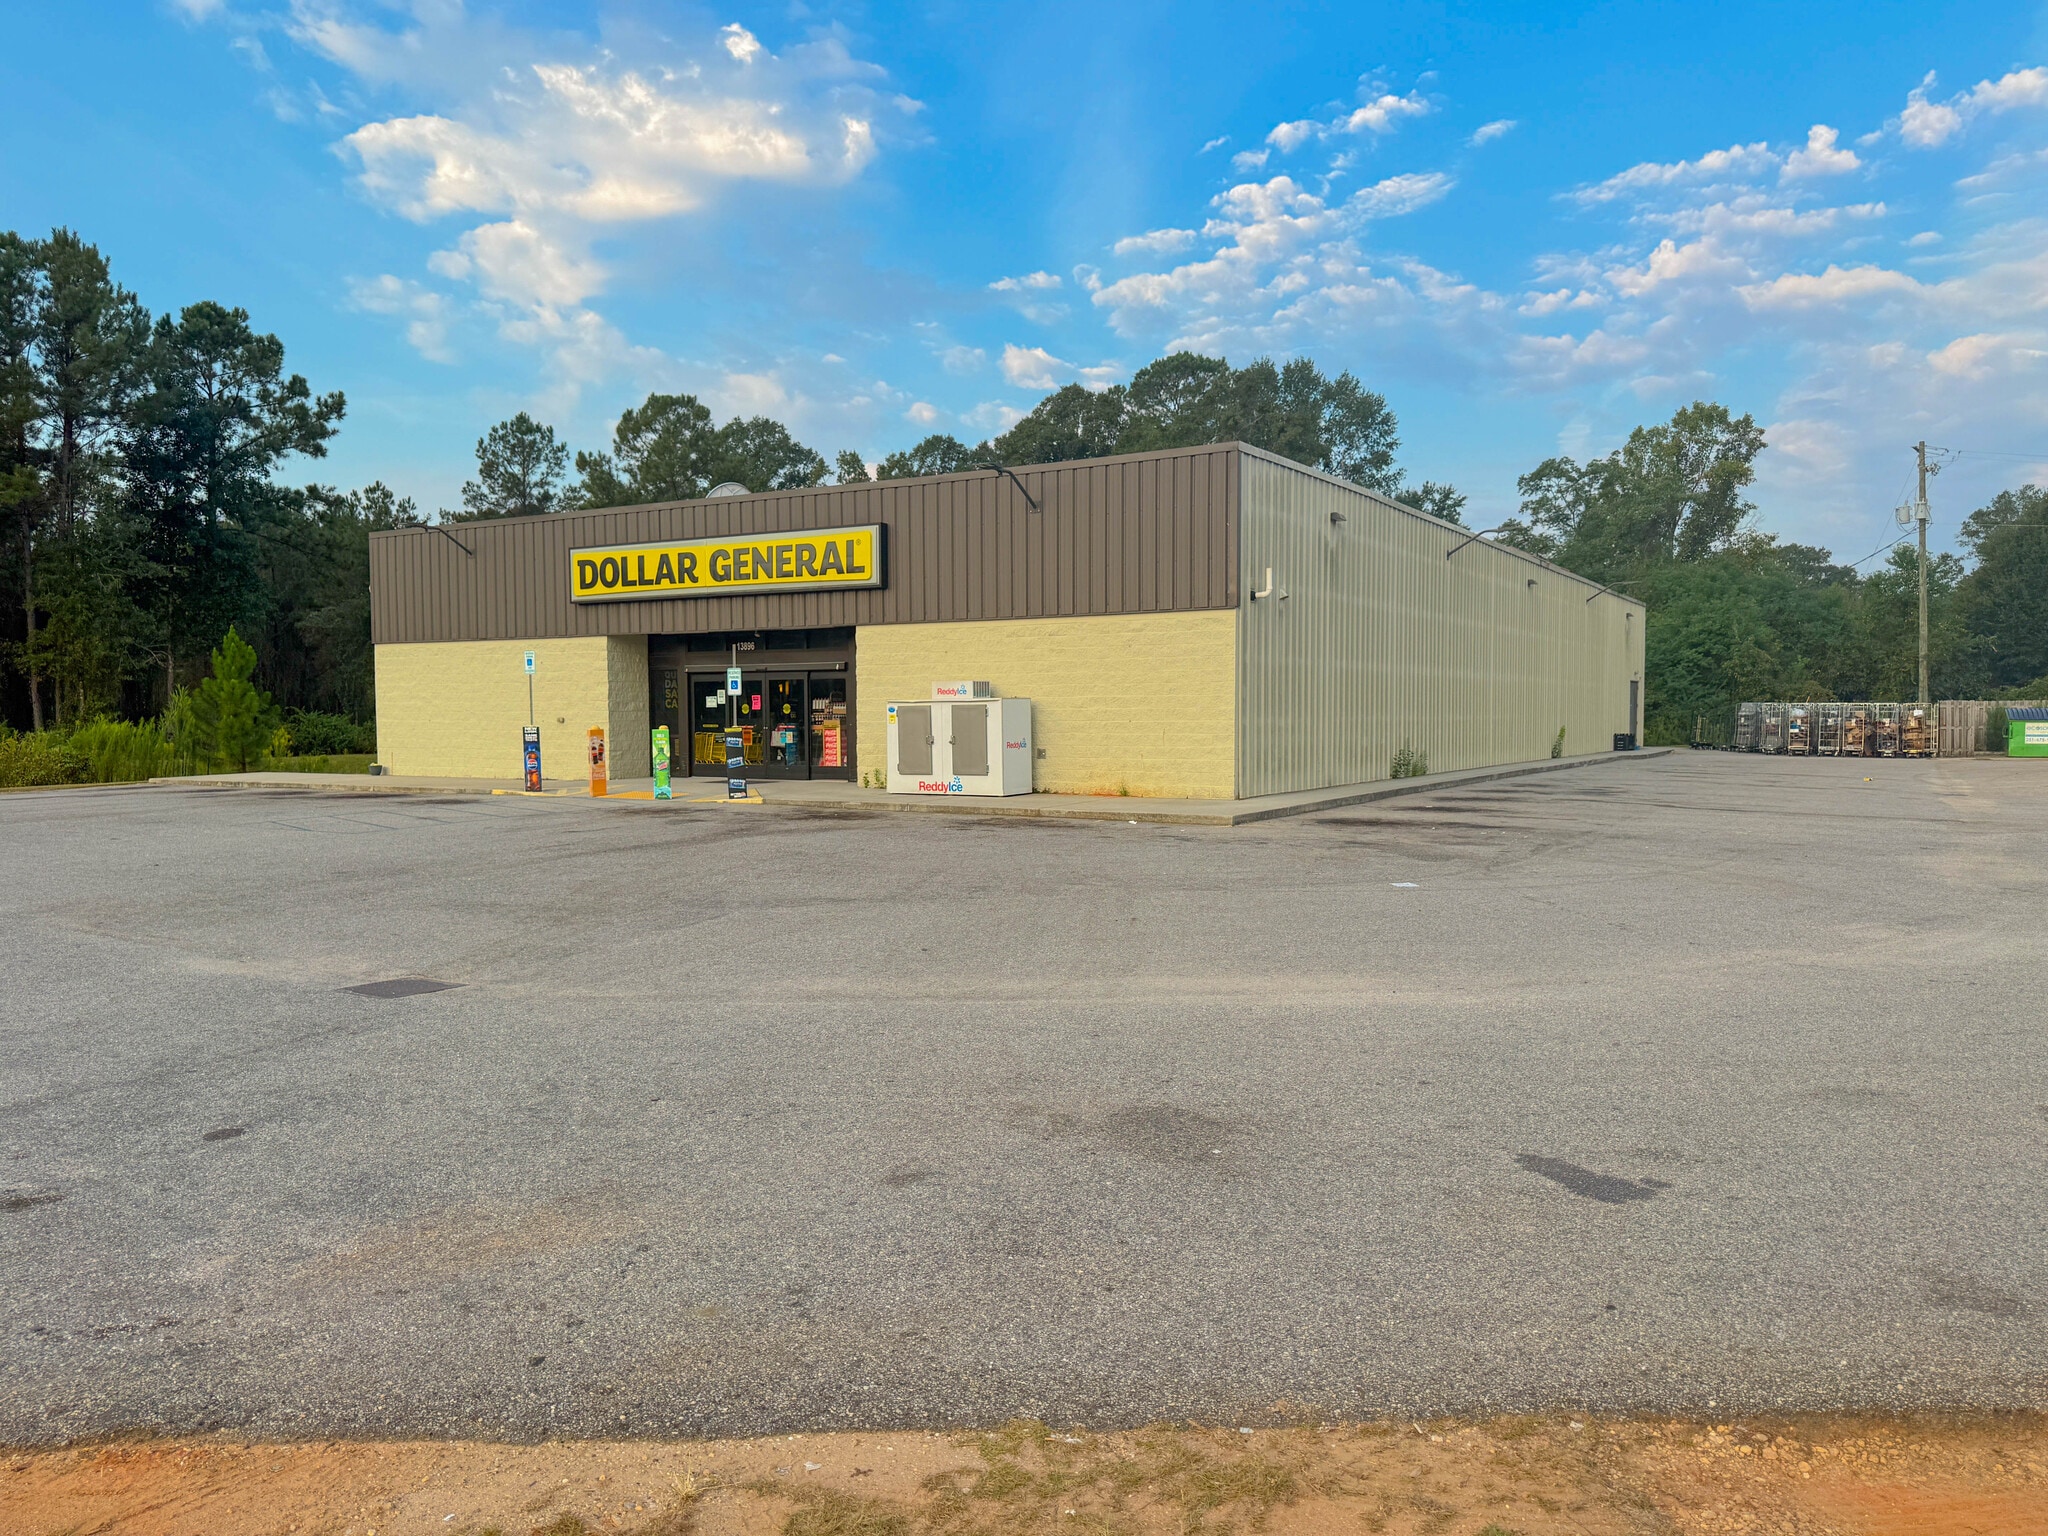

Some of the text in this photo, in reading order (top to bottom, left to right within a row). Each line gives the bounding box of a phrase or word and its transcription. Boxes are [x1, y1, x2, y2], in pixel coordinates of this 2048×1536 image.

[577, 539, 865, 590] DOLLAR GENERAL
[737, 642, 755, 650] 13896
